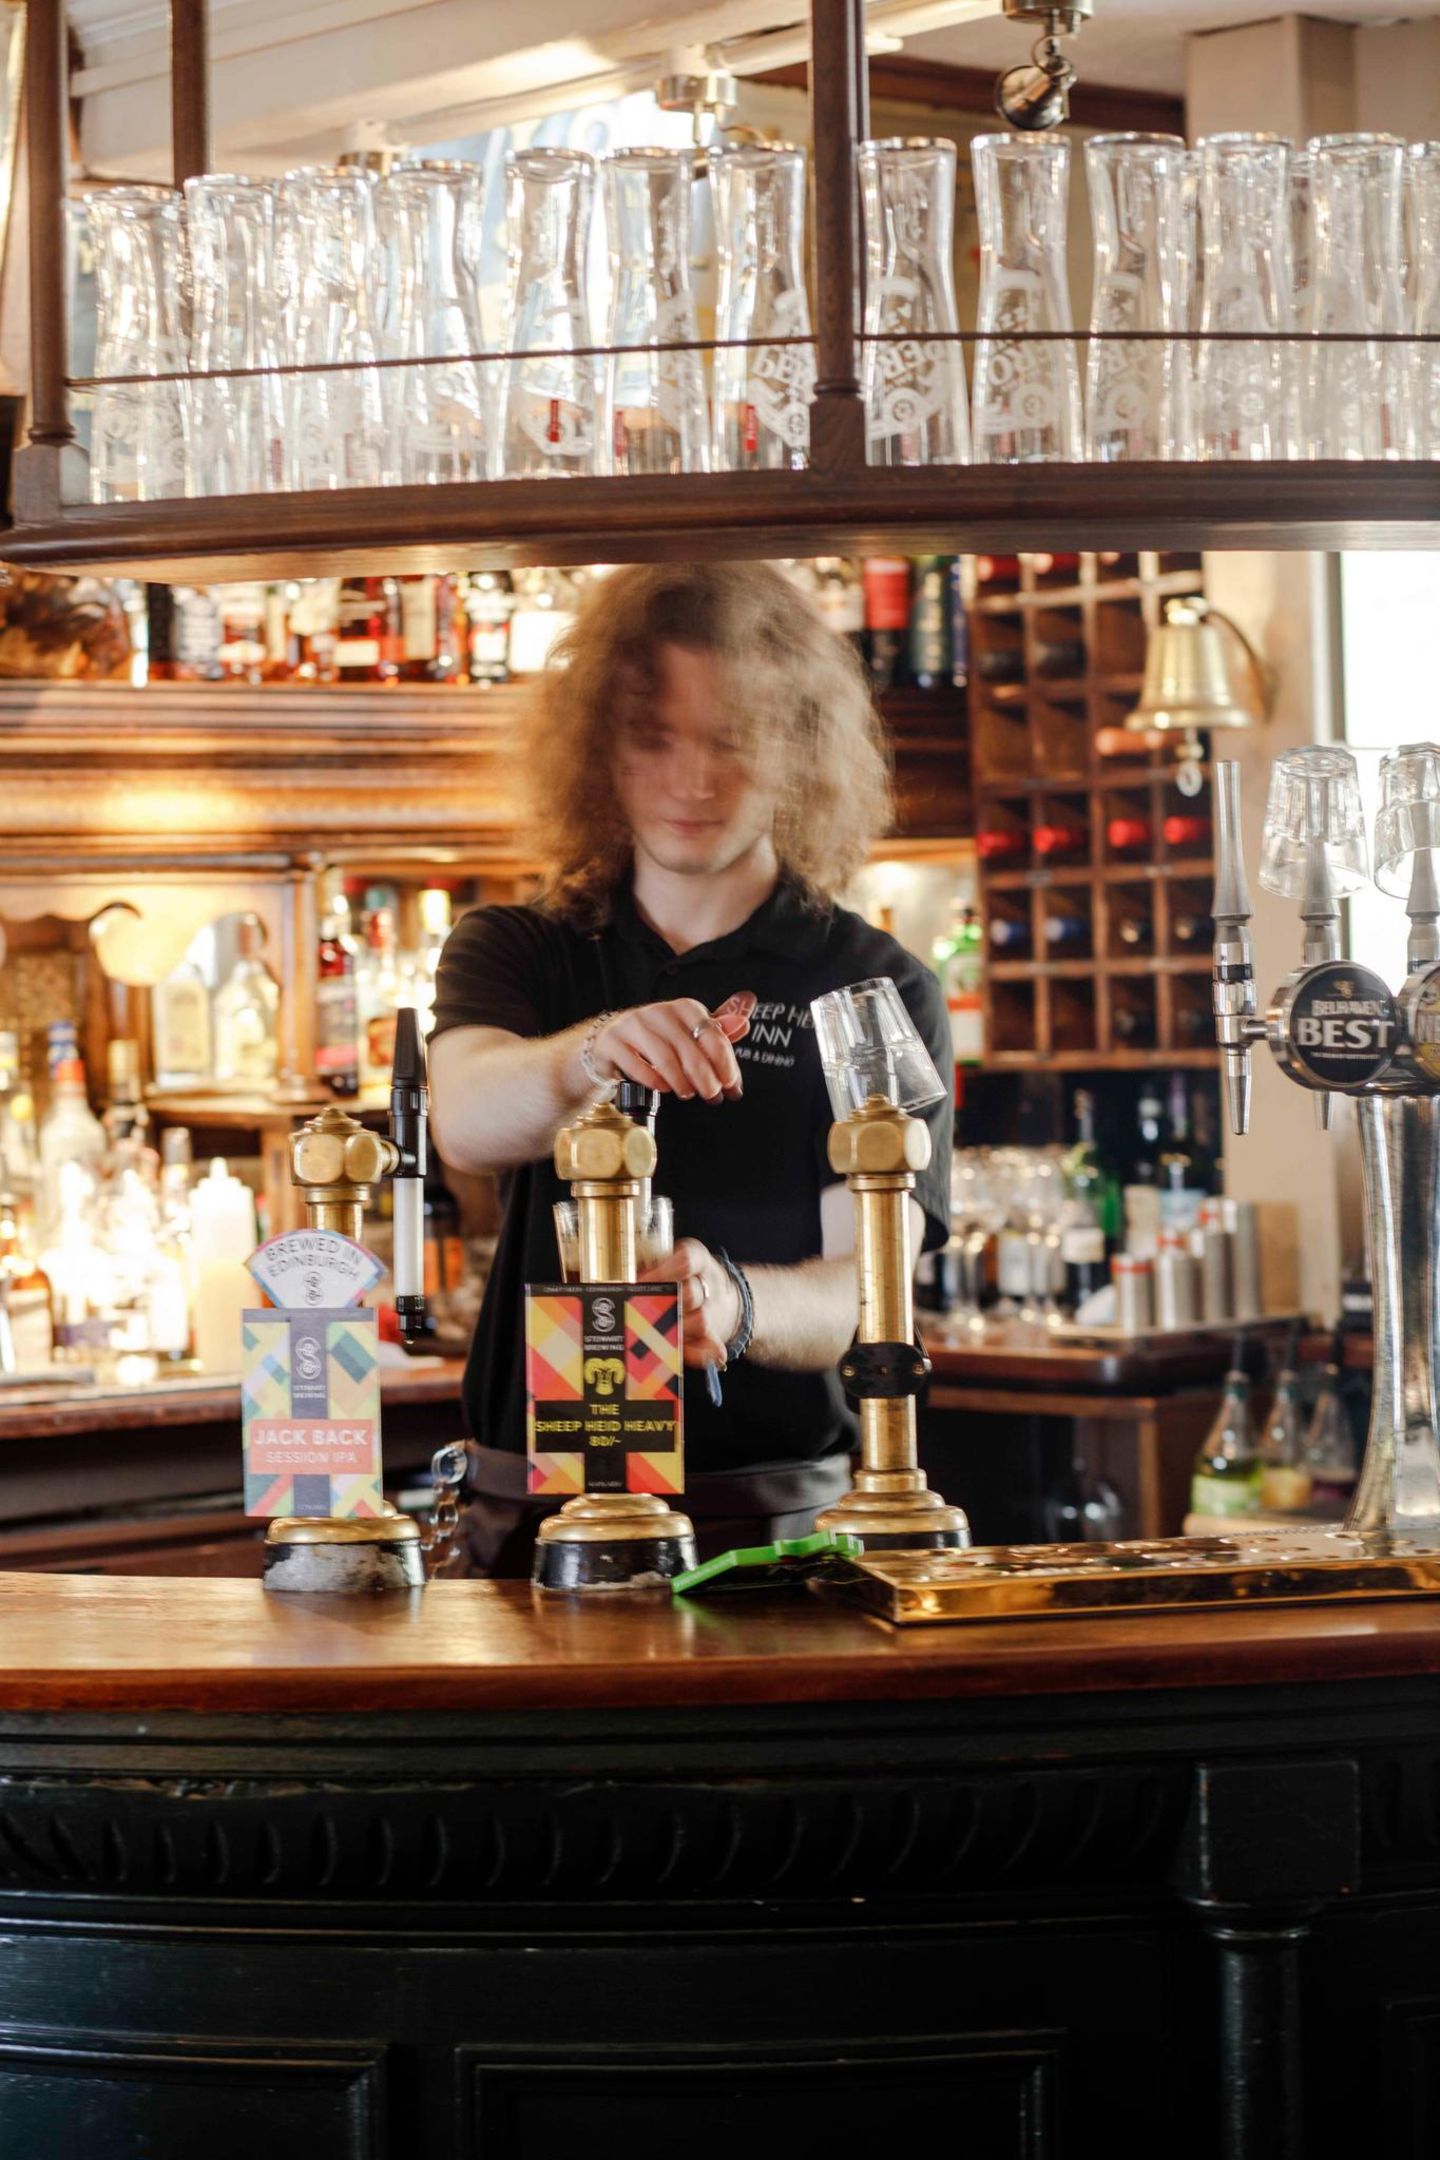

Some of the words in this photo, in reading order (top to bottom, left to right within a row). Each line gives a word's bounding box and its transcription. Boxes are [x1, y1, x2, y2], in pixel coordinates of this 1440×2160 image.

[787, 1004, 817, 1029] HE
[752, 1023, 792, 1048] INN
[1297, 1018, 1395, 1049] BEST
[266, 1238, 339, 1261] BREWED
[342, 1244, 361, 1265] IN
[267, 1254, 360, 1281] EDINBURGH
[589, 1404, 620, 1415] THE
[255, 1429, 307, 1445] JACK
[312, 1429, 368, 1445] BACK
[535, 1420, 582, 1432] SHEEP
[584, 1420, 621, 1432] HEID
[623, 1420, 675, 1432] HEAVY
[265, 1451, 329, 1464] SESSION
[333, 1451, 358, 1463] IPA
